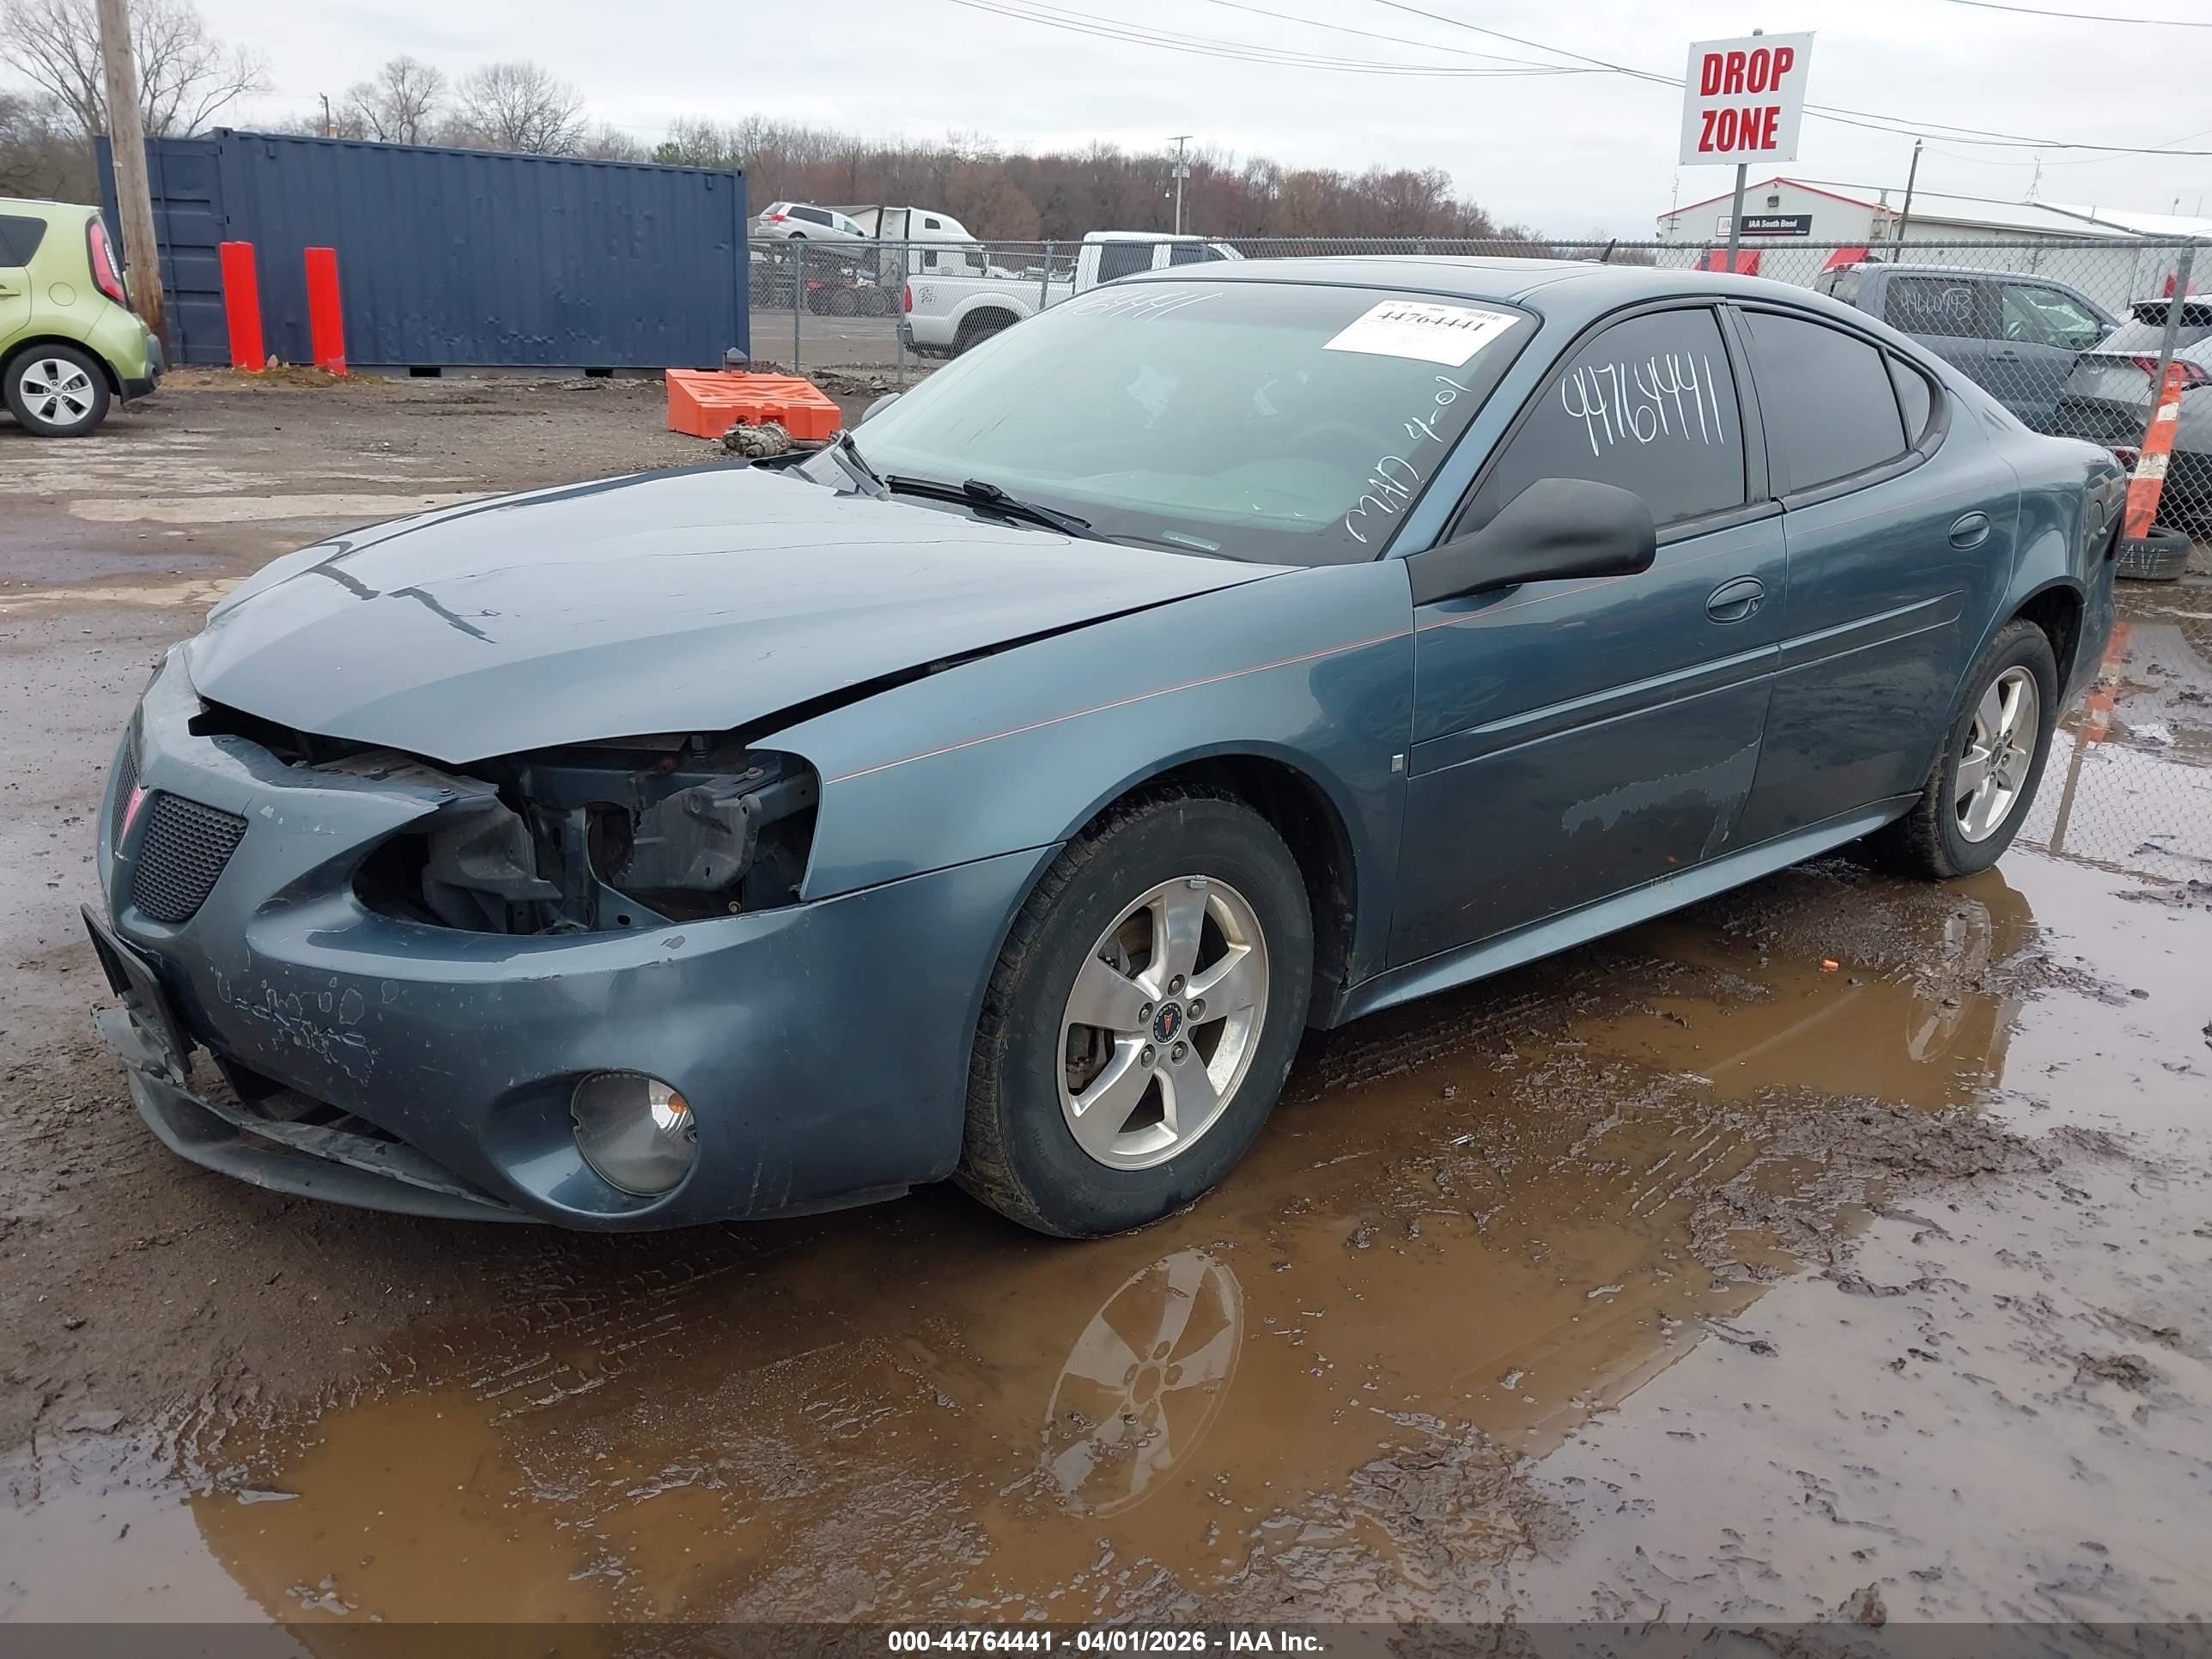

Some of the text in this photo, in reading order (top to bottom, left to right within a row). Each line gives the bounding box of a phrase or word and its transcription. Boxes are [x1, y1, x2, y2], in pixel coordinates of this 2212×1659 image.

[1699, 46, 1796, 97] DROP
[1698, 105, 1782, 153] ZONE
[1761, 219, 1780, 228] South
[1376, 310, 1486, 331] 44764441
[1561, 350, 1724, 457] 44764441
